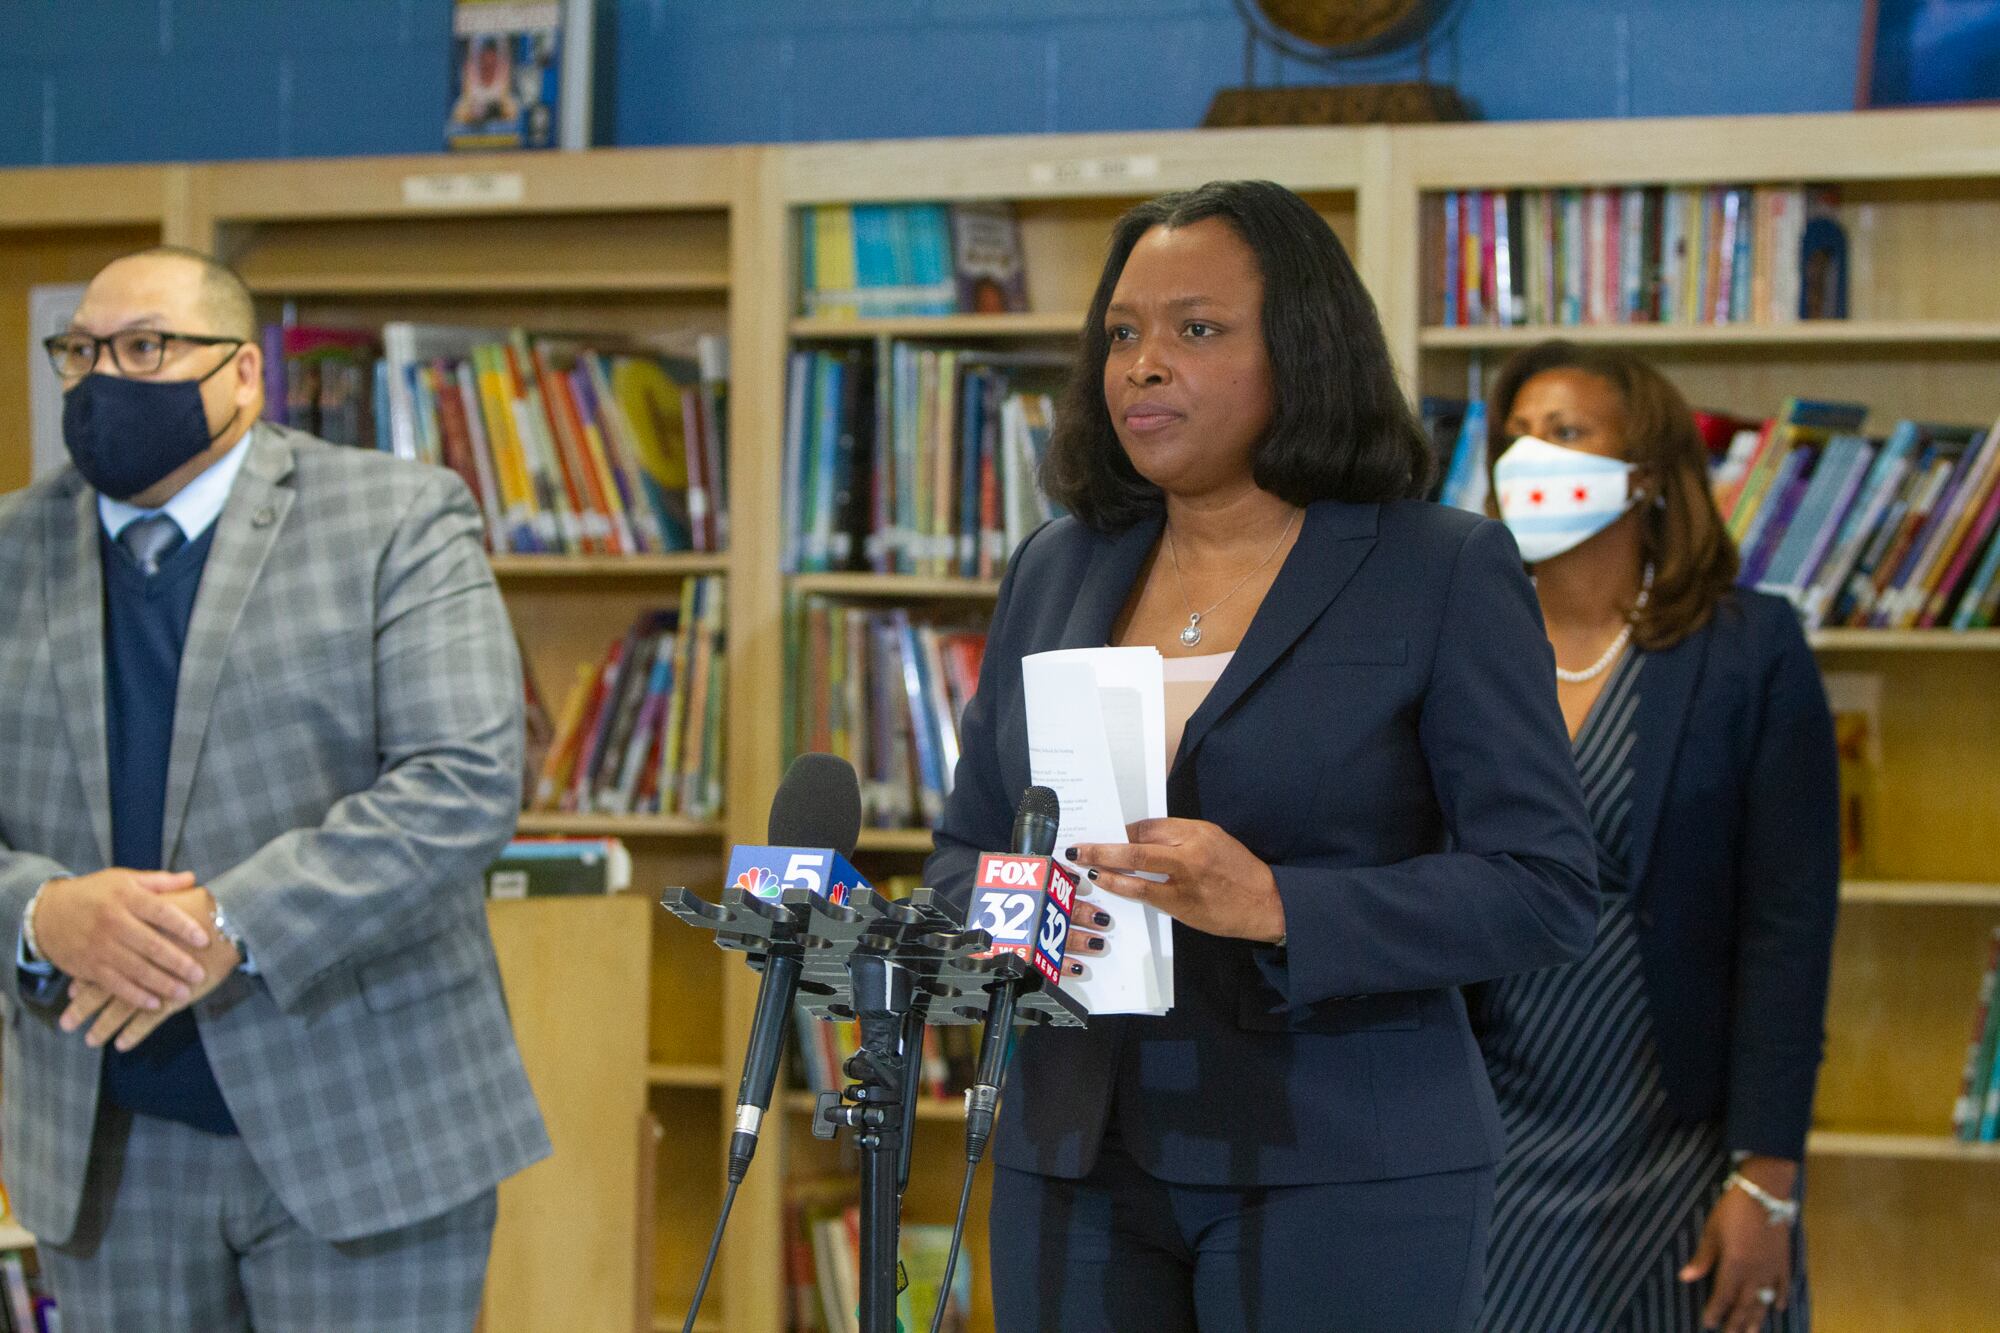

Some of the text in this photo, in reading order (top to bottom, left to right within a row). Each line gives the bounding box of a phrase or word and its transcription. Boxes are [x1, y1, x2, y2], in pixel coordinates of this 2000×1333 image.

[782, 854, 823, 895] 5
[985, 860, 1041, 886] FOX
[1050, 868, 1074, 910] FOX
[972, 892, 1035, 940] 32
[1040, 902, 1067, 962] 32
[1034, 952, 1059, 982] NEWS
